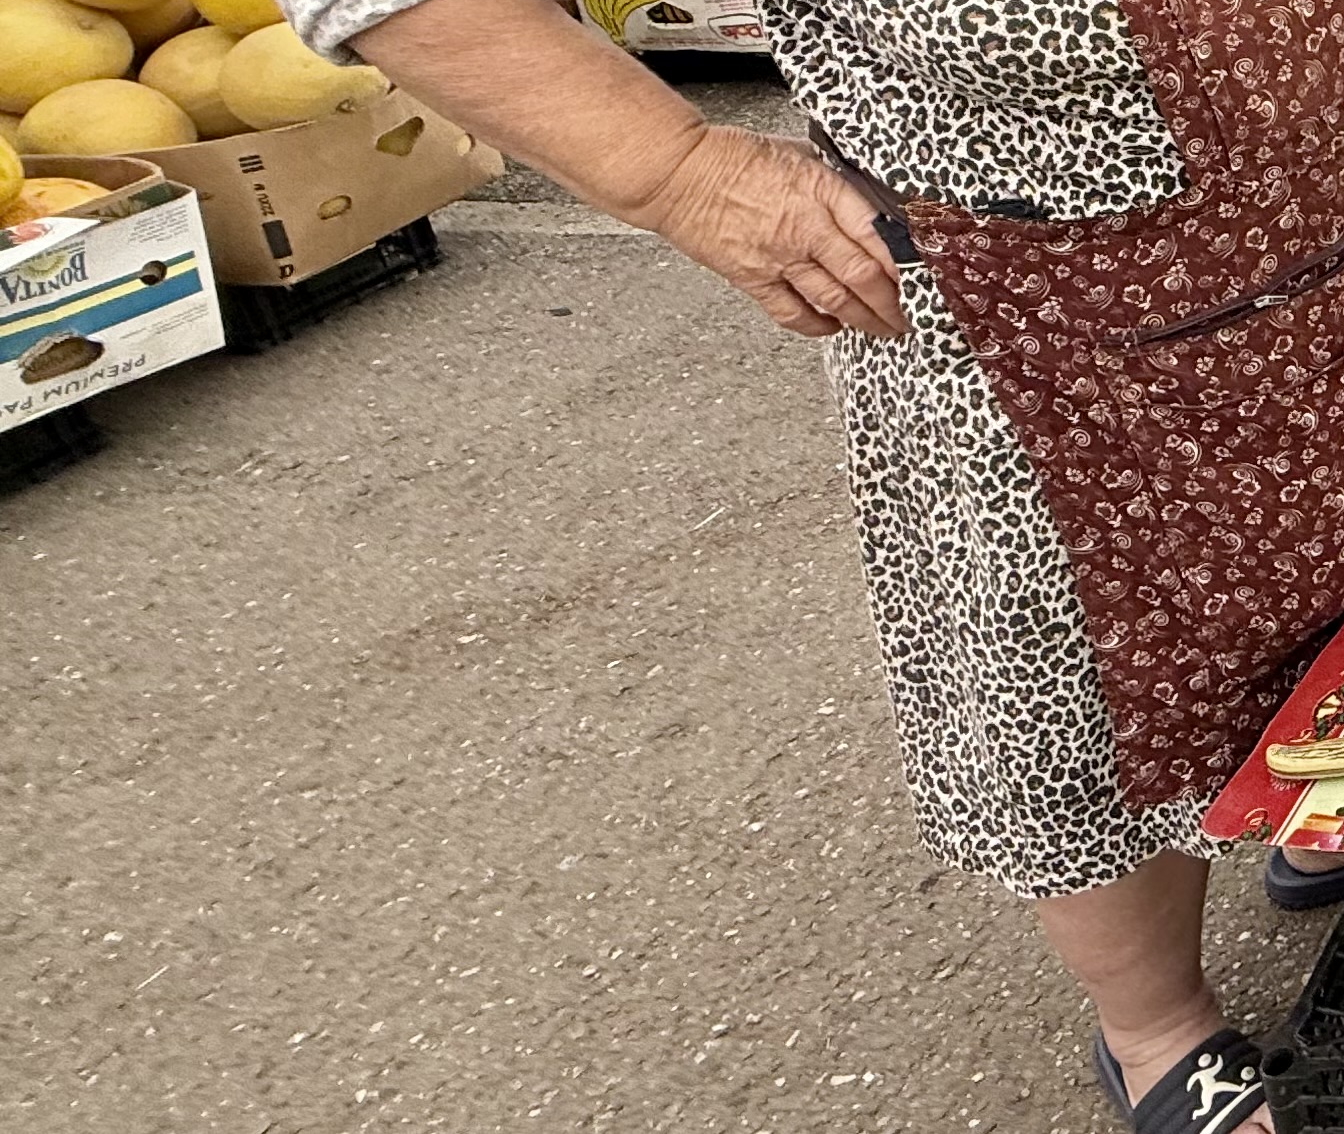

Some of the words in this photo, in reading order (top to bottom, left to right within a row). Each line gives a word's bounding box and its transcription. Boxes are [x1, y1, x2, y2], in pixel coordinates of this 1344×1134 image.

[720, 23, 763, 41] Dole
[0, 250, 90, 305] BONITA
[42, 353, 147, 403] PREMIUM
